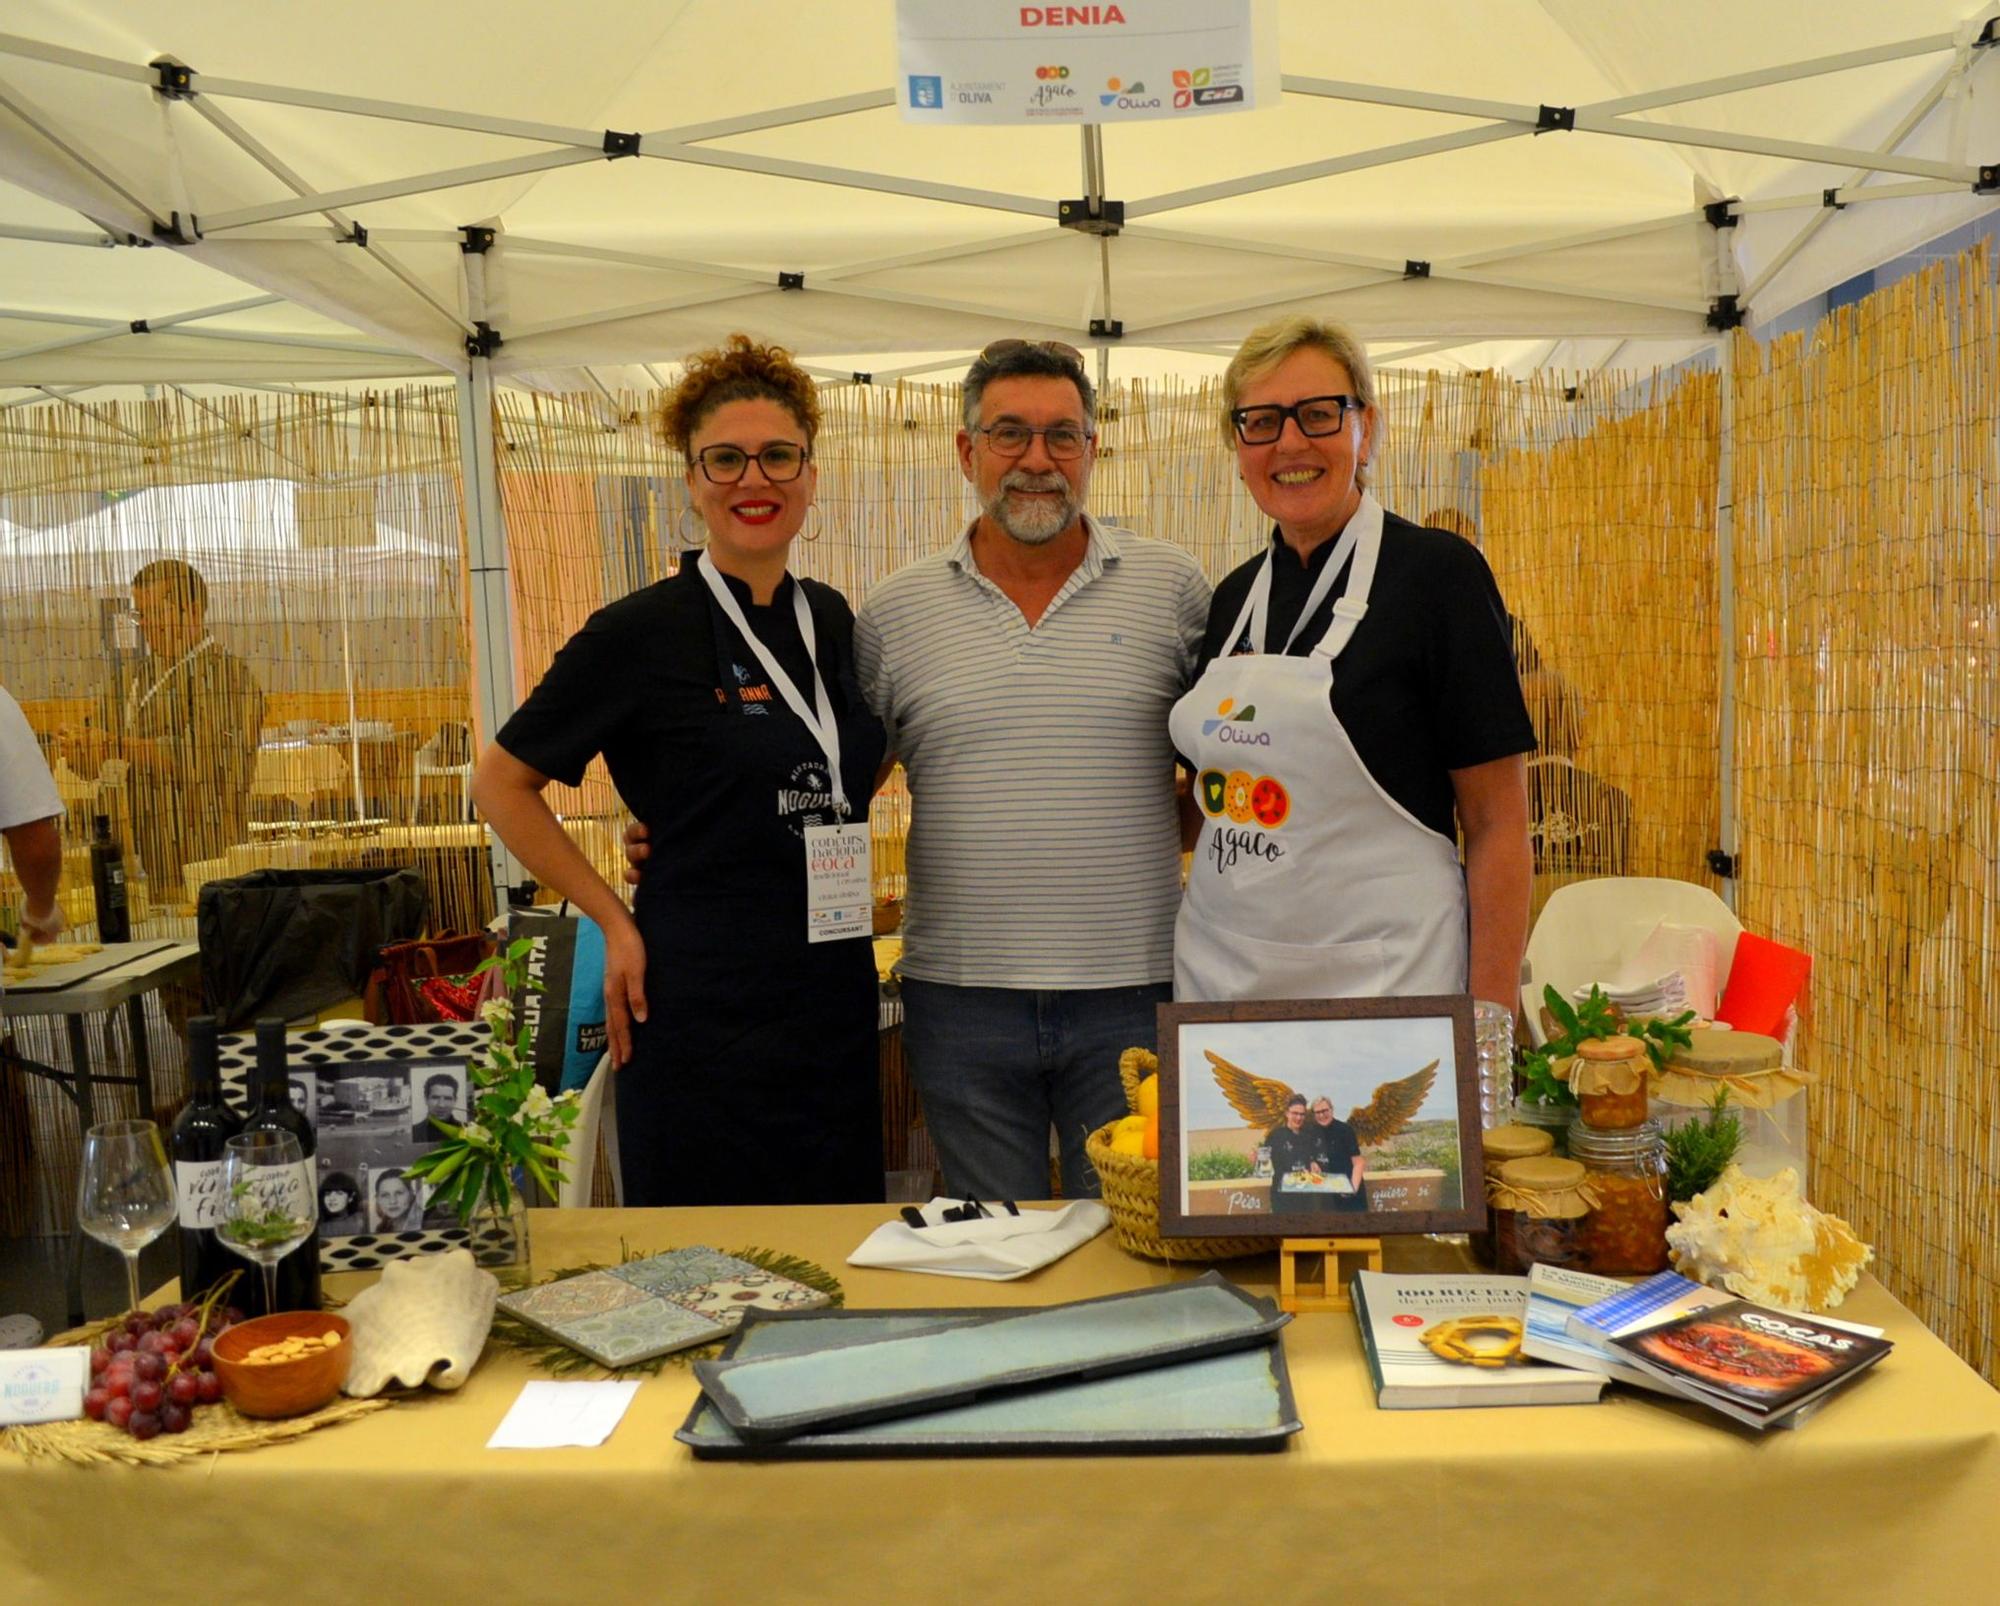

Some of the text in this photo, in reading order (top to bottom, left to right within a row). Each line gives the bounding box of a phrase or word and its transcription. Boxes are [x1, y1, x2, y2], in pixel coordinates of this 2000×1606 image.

[1020, 4, 1126, 27] DENIA
[1208, 827, 1285, 874] Agaco
[819, 925, 864, 936] CONCURSANT
[1397, 1289, 1434, 1297] 100
[1740, 1313, 1854, 1350] COCAS
